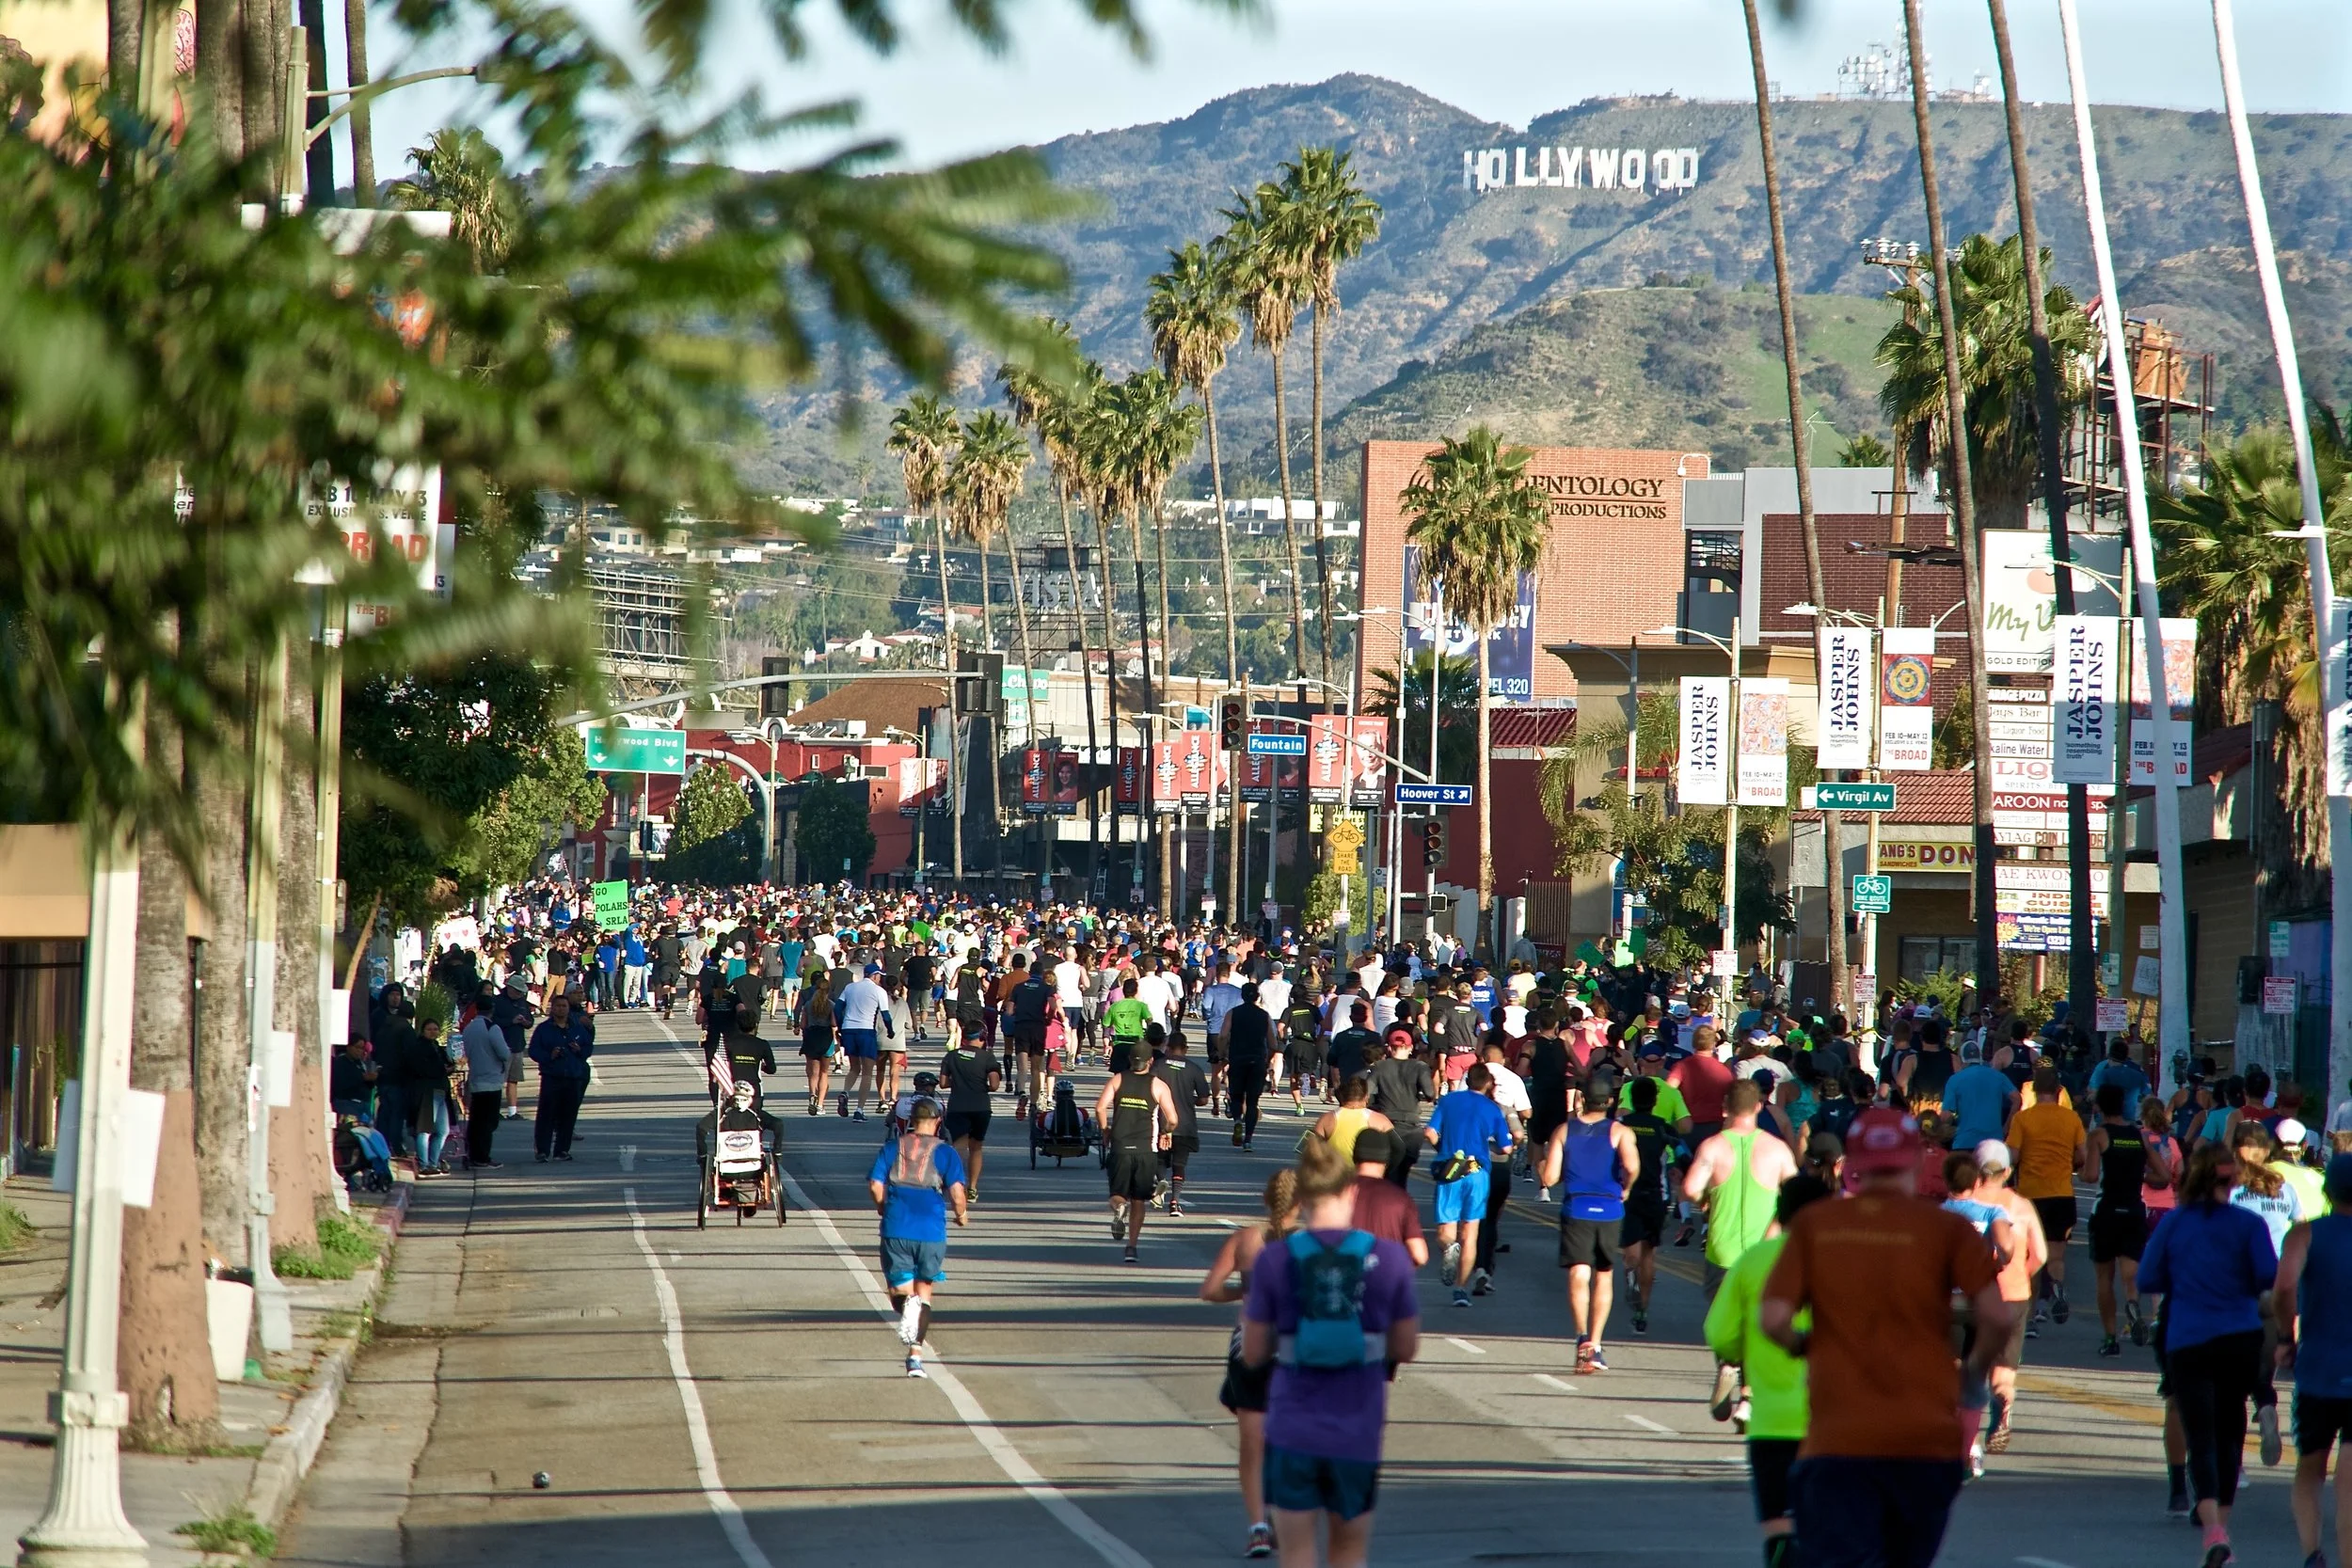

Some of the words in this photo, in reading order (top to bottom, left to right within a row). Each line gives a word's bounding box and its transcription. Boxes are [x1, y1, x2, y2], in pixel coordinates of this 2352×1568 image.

[1464, 146, 1698, 191] HOLLYWOOD
[1526, 475, 1664, 497] ENTOLOGY
[1551, 502, 1666, 519] PRODUCTIONS
[1987, 657, 2013, 666] GOLD
[2016, 657, 2054, 667] EDITION
[1507, 678, 1529, 694] 320
[1831, 635, 1845, 731] JASPER
[2067, 626, 2086, 739] JASPER
[1846, 648, 1860, 732] JOHNS
[2086, 641, 2104, 740] JOHNS
[2020, 707, 2042, 718] Bar
[1691, 684, 1704, 770] JASPER
[1705, 696, 1718, 770] JOHNS
[654, 738, 678, 748] Blvd
[1251, 738, 1302, 751] Fountain
[2019, 744, 2044, 755] Water
[1895, 750, 1928, 760] BROAD
[1032, 752, 1041, 799] ALLEGIANCE
[1125, 751, 1134, 799] ALLEGIANCE
[1995, 761, 2049, 780] LIQ
[1401, 787, 1439, 799] Hoover
[1443, 789, 1455, 800] St
[1752, 787, 1783, 797] BROAD
[1836, 790, 1869, 804] Virgil
[1873, 791, 1889, 802] Av
[1994, 795, 2051, 808] AROON
[2035, 832, 2058, 846] COIN
[1879, 844, 1915, 858] ANG'S
[1919, 845, 1976, 865] DON
[596, 887, 607, 895] GO
[596, 901, 628, 912] POLAHS
[606, 915, 628, 926] SRLA
[2260, 1201, 2276, 1212] RUN
